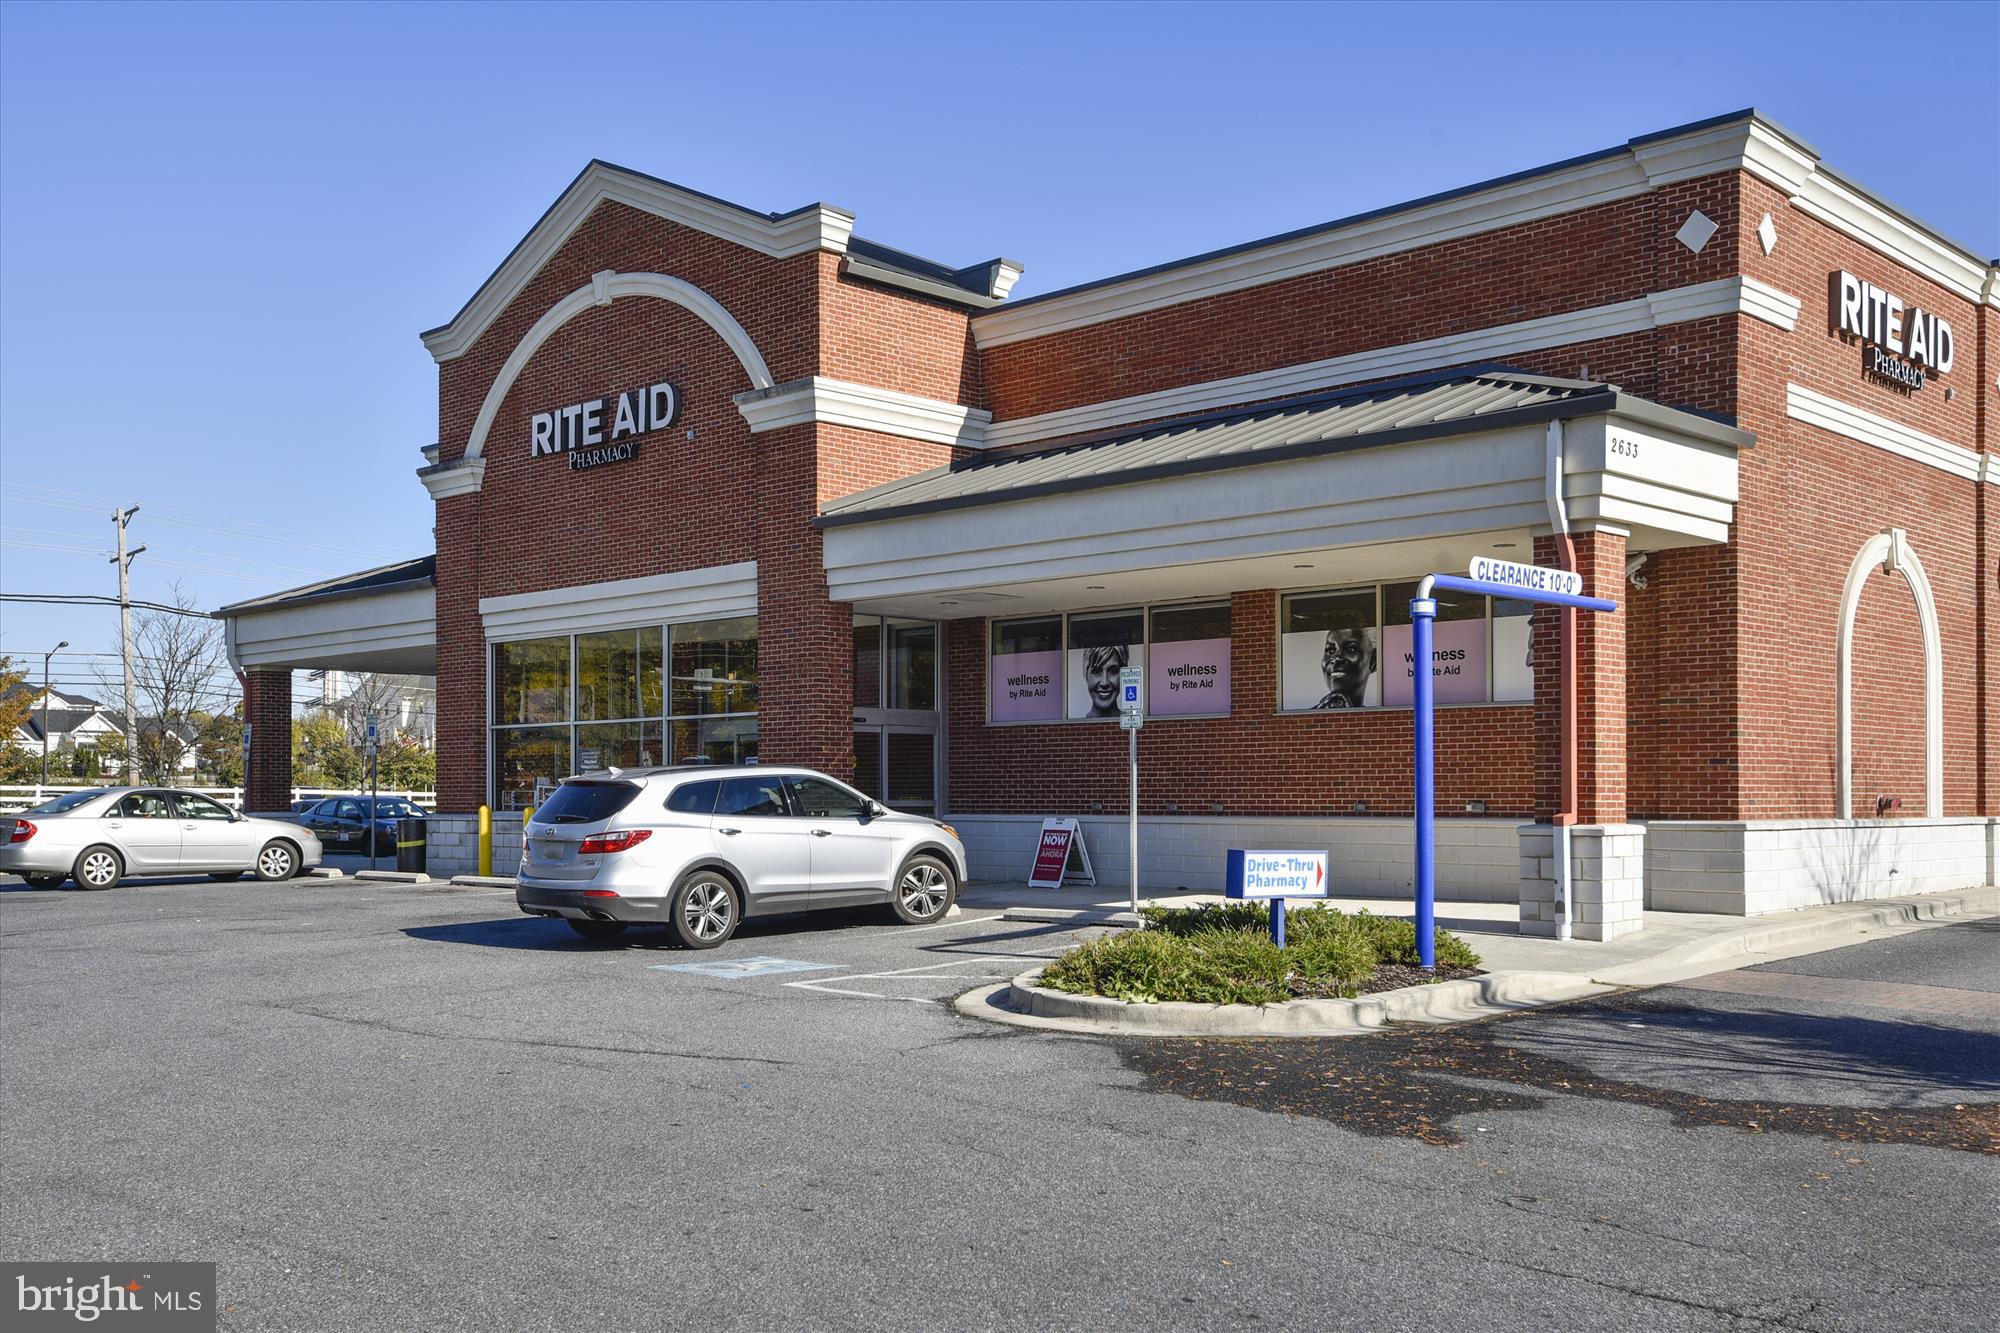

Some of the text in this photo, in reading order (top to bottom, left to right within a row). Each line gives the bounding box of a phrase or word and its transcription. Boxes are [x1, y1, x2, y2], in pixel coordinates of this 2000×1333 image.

[1841, 270, 1954, 374] RITE AID
[1873, 347, 1926, 390] PHARMACY
[531, 382, 675, 457] RITE AID
[1611, 437, 1638, 458] 2633
[568, 443, 634, 470] PHARMACY
[1477, 560, 1545, 589] CLEARANCE
[1404, 649, 1465, 663] wness
[1167, 664, 1217, 676] wellness
[1443, 665, 1460, 676] Aid
[1007, 674, 1049, 686] wellness
[1170, 679, 1213, 691] by Rite Aid
[1010, 688, 1046, 700] by Rite Aid
[1043, 835, 1067, 846] NOW
[1247, 858, 1313, 873] Drive-Thru
[1247, 874, 1307, 890] Pharmacy
